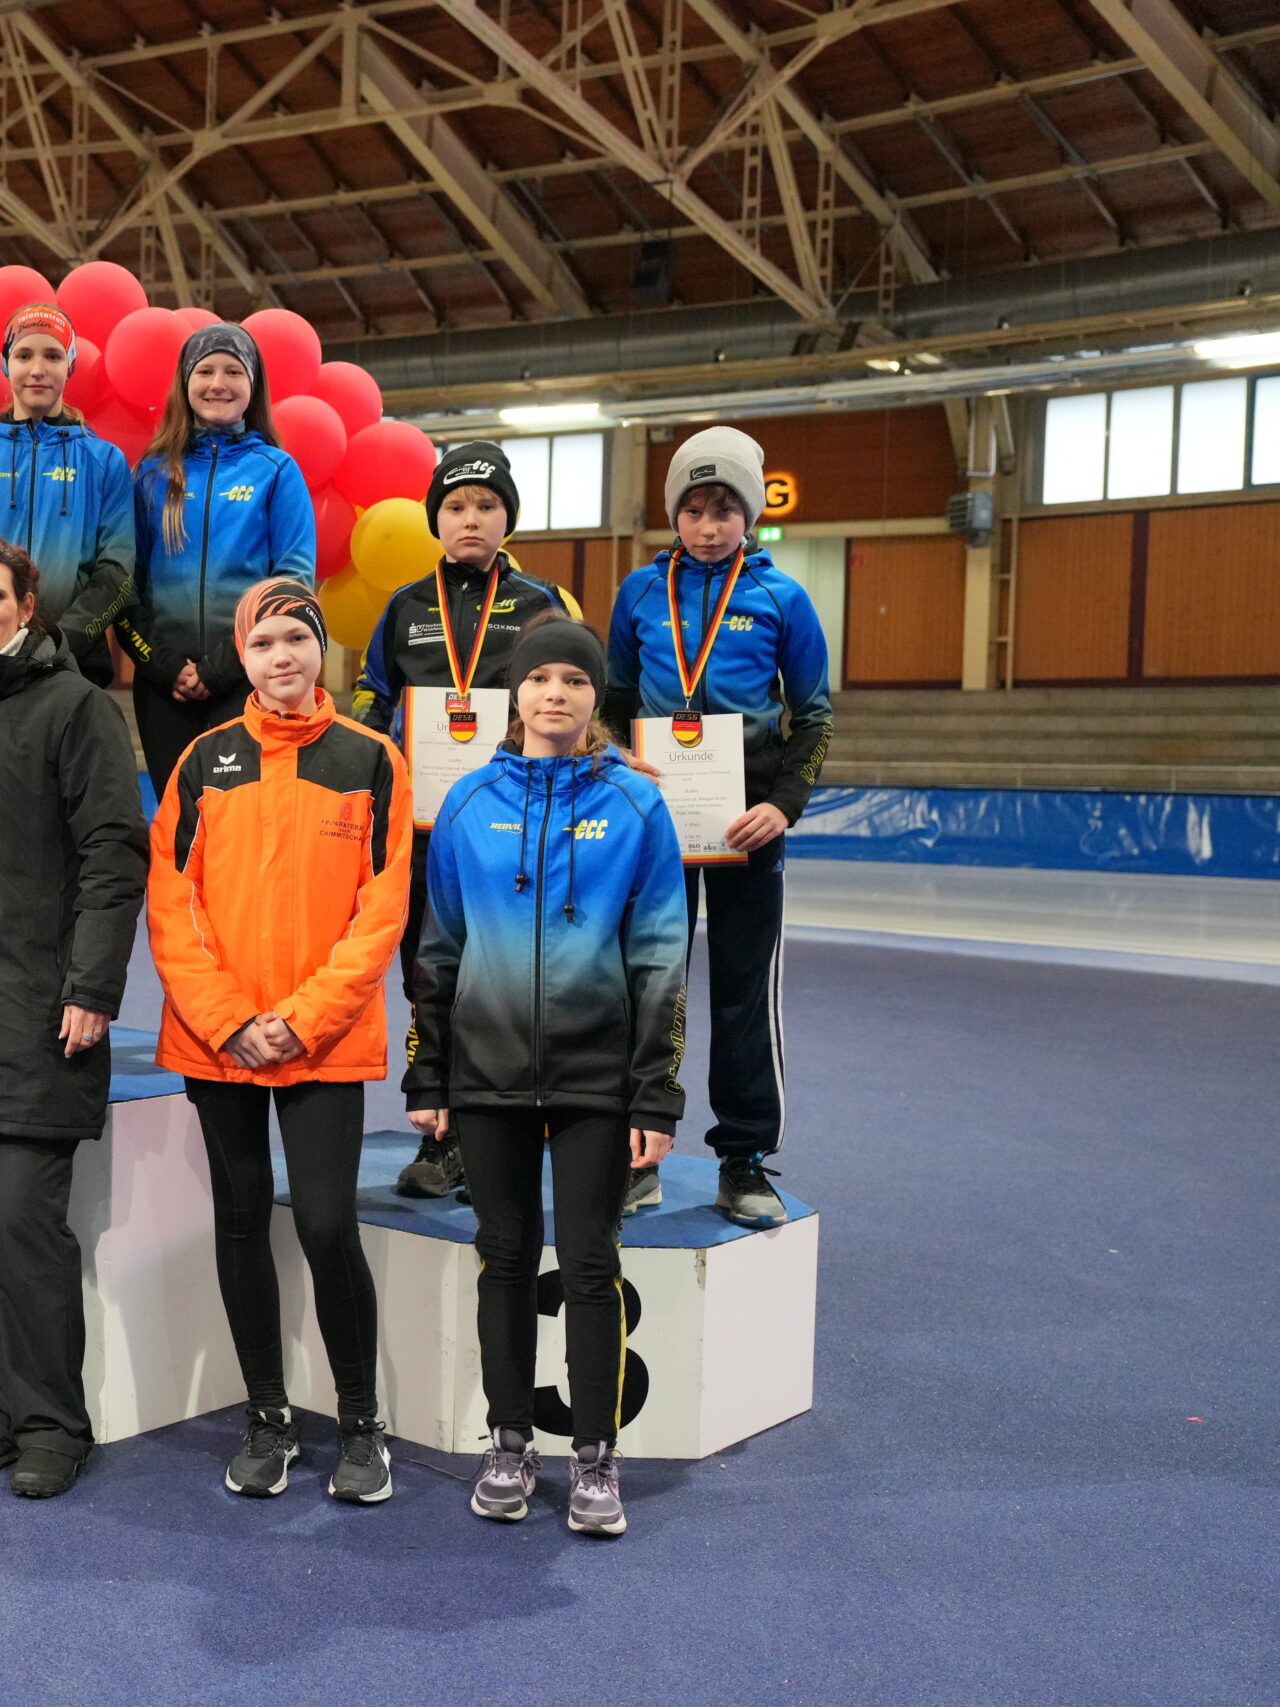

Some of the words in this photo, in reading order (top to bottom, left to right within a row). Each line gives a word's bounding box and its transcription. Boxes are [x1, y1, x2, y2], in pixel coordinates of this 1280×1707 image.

[669, 752, 714, 762] Urkunde
[213, 765, 242, 773] erima
[489, 822, 523, 831] REDVIL
[532, 1268, 649, 1438] 3
